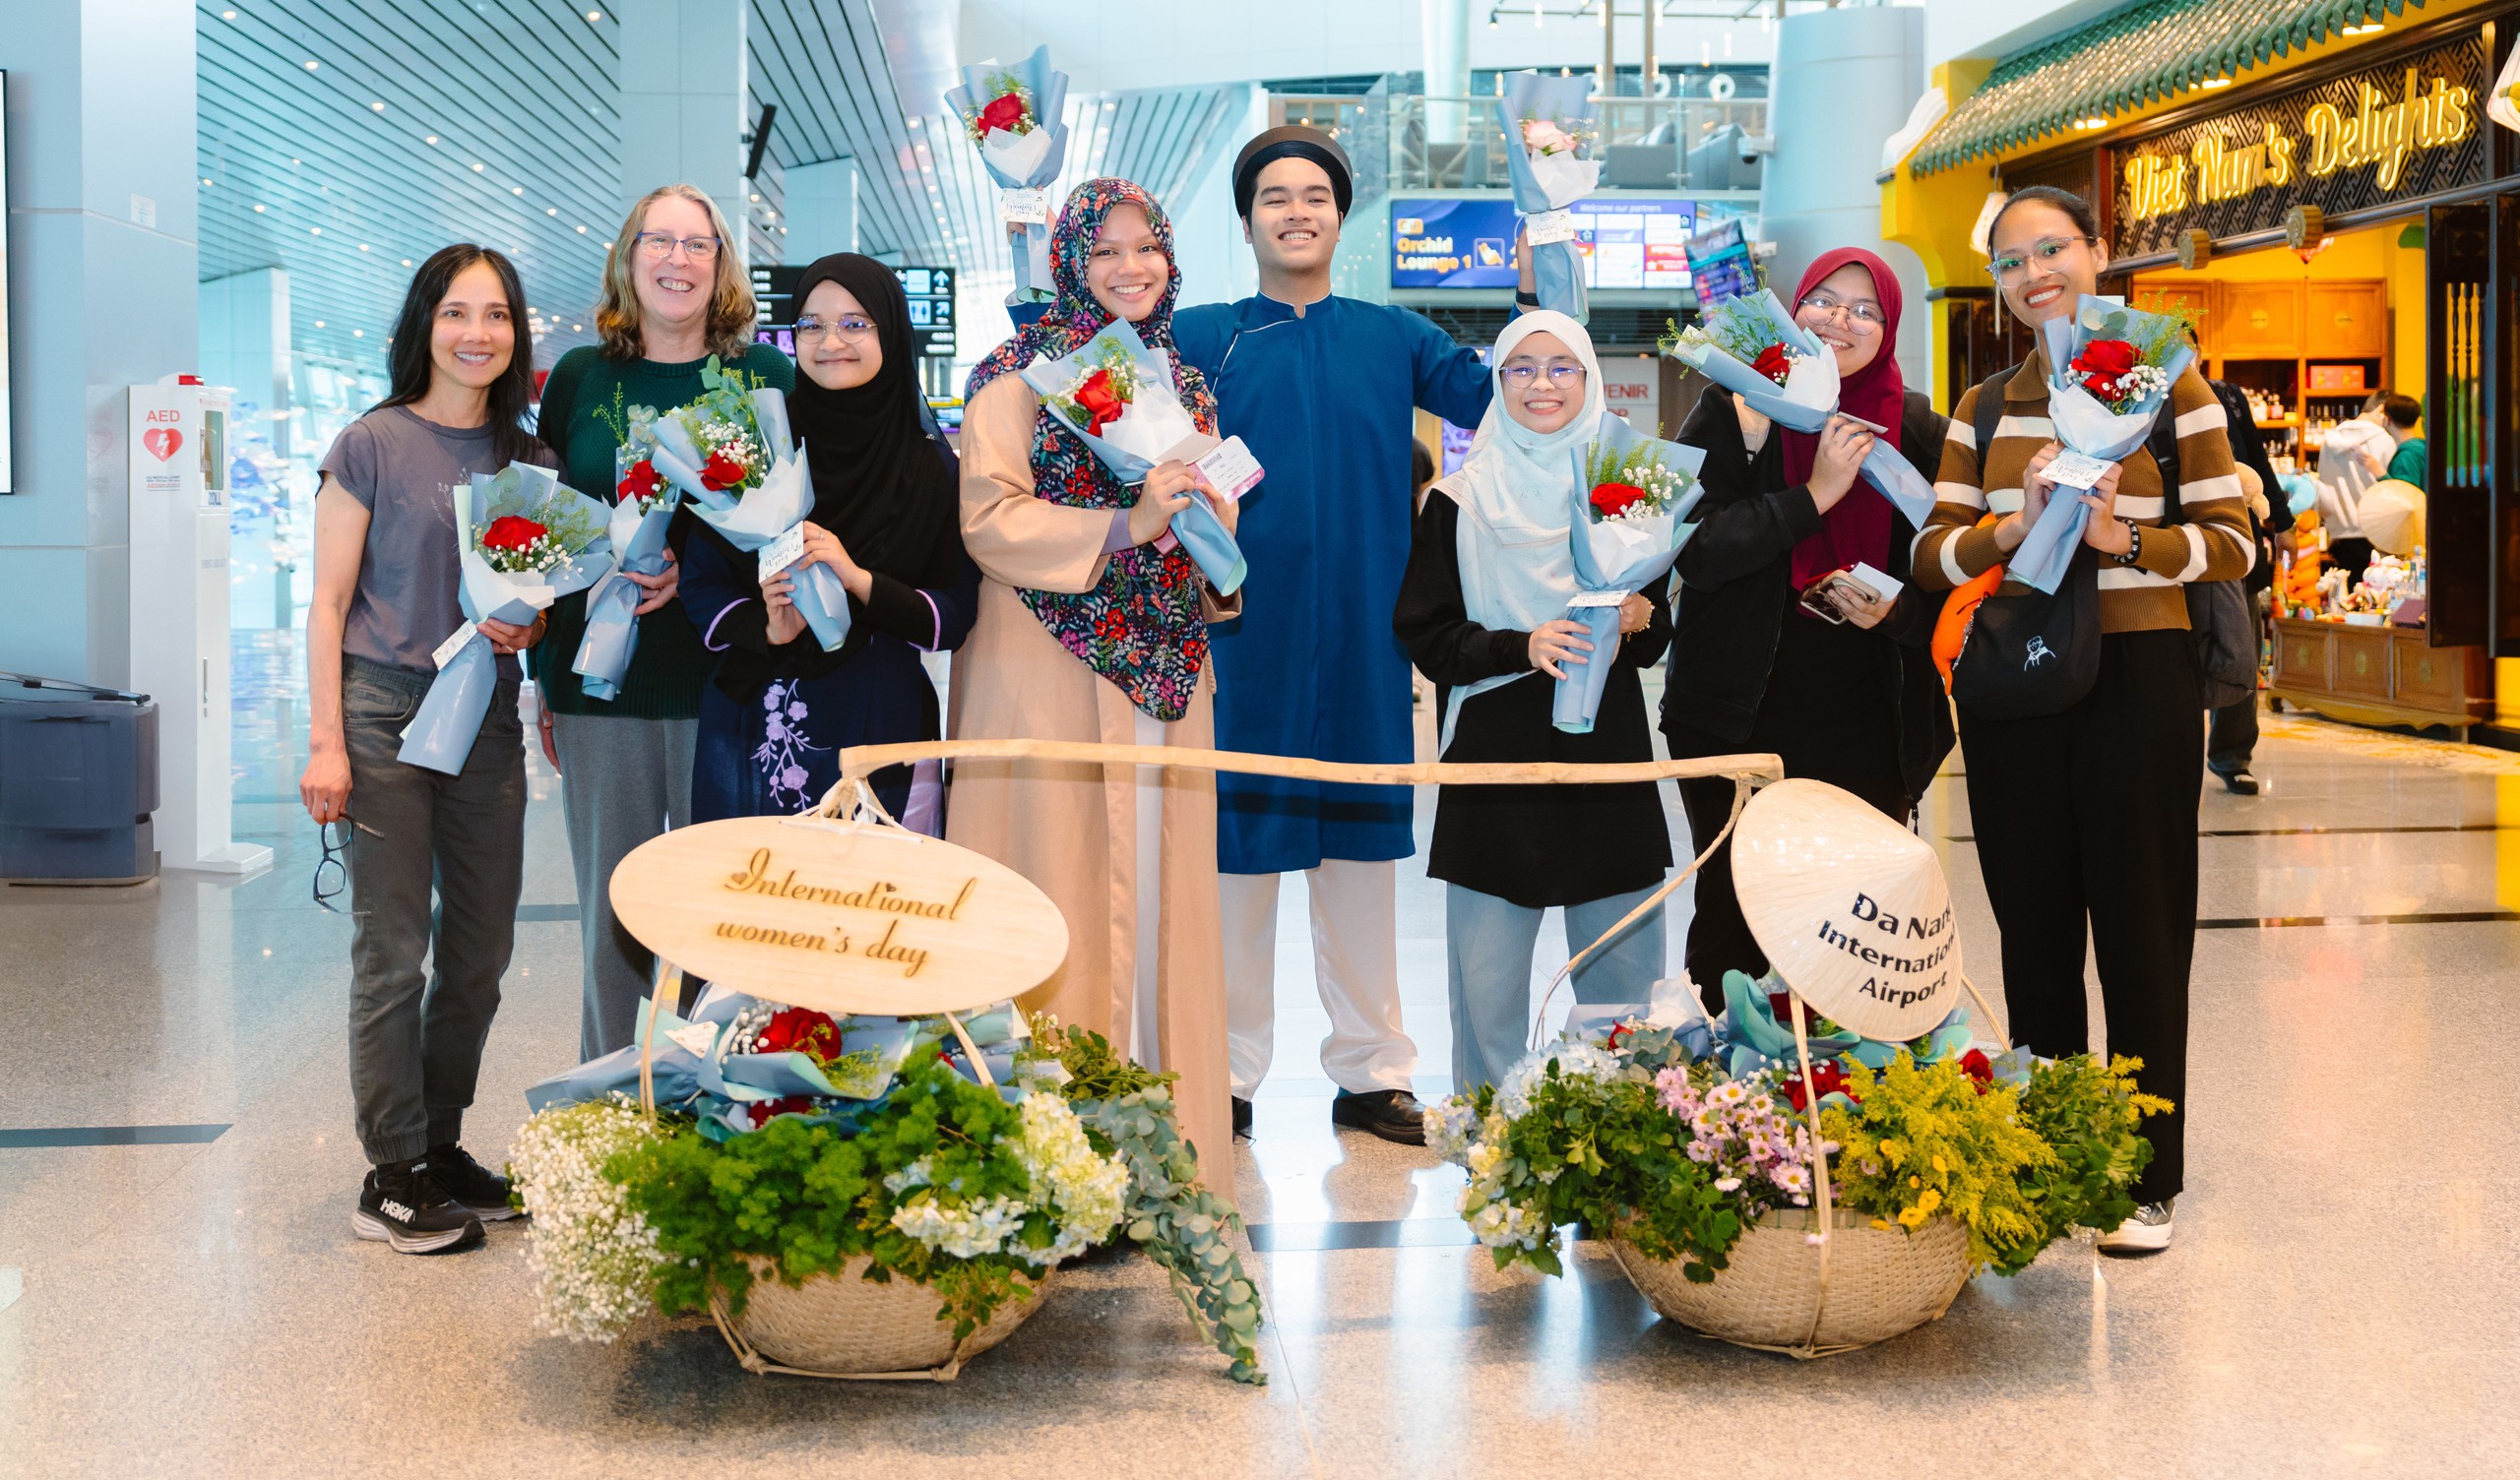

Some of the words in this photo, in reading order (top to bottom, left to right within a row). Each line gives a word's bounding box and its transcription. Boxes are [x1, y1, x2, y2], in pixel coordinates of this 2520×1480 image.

[2125, 154, 2186, 220] Viet
[2191, 122, 2292, 205] Nam's
[2304, 68, 2469, 191] Delights
[1579, 204, 1613, 213] Welcome
[1397, 236, 1453, 253] Orchid
[1397, 254, 1459, 274] Lounge
[1462, 254, 1472, 269] 1
[146, 409, 181, 422] AED
[724, 847, 976, 921] International
[1851, 892, 1899, 936] Da
[717, 920, 850, 955] women's
[865, 919, 929, 977] day
[1858, 970, 1947, 1009] Airport
[410, 1162, 427, 1173] HOKA
[380, 1198, 413, 1223] HOKA
